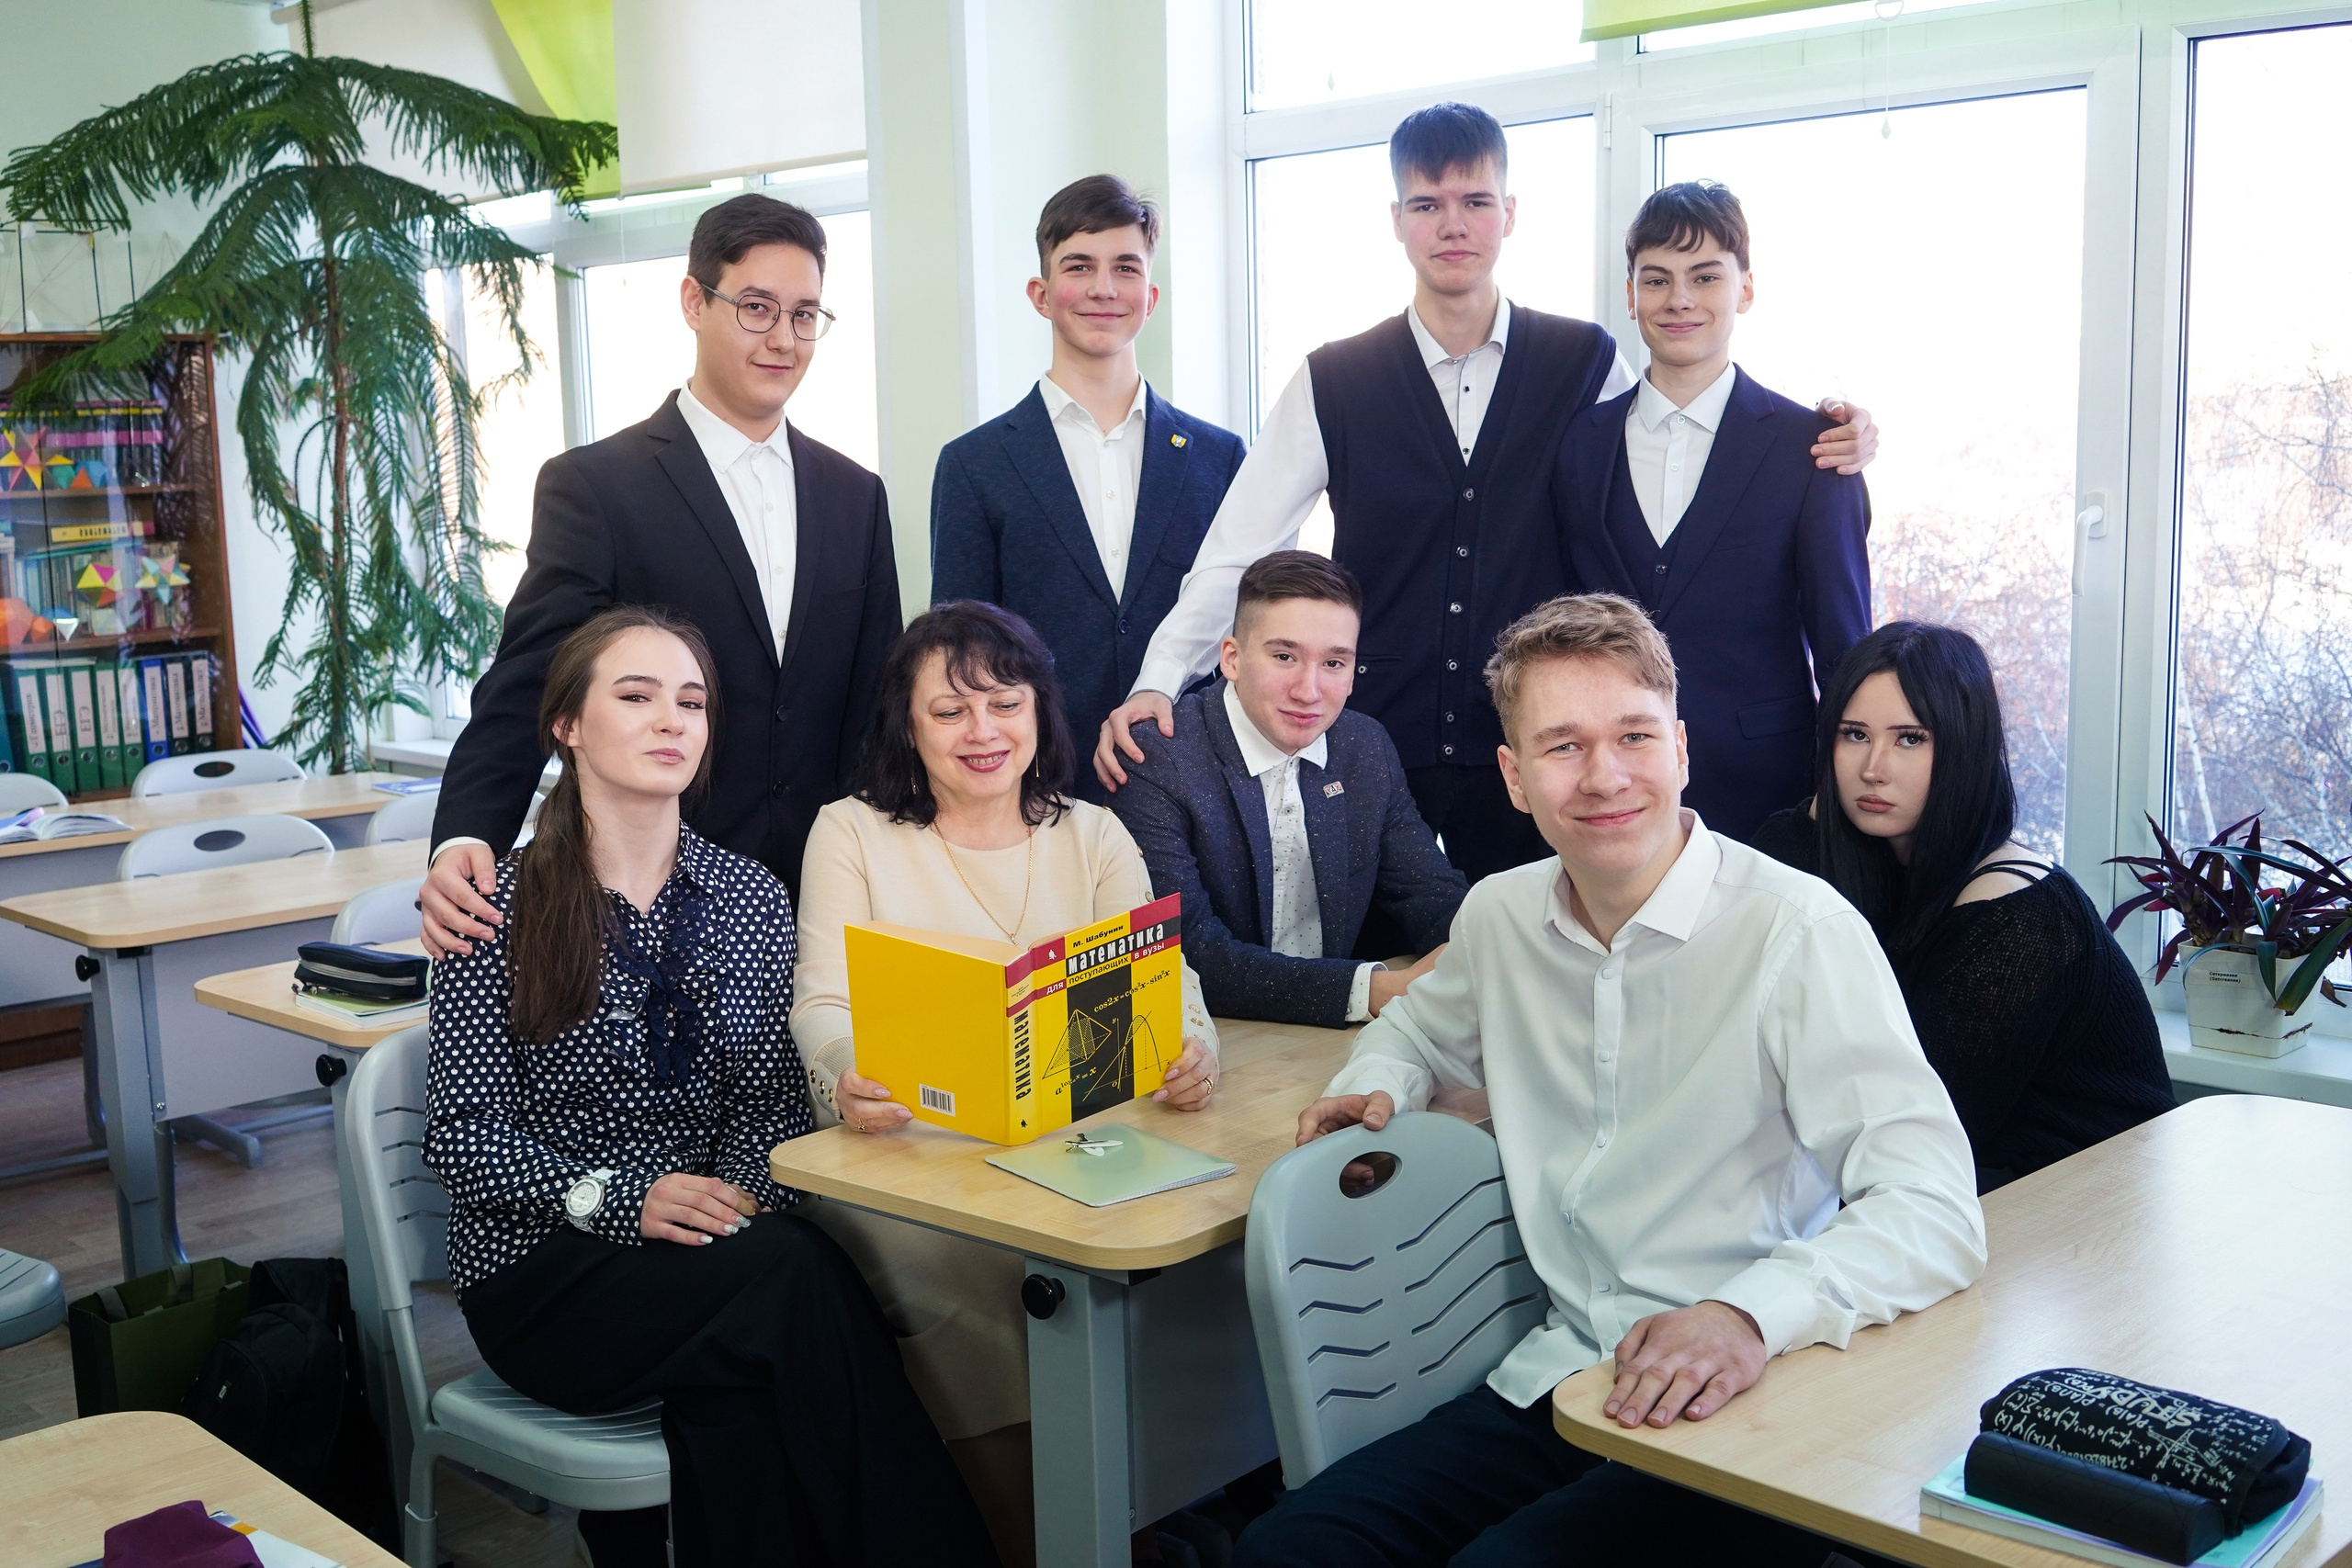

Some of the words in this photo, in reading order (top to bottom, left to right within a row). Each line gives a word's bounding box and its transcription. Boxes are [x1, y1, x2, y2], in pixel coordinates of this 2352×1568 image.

[1068, 923, 1164, 976] математика
[1072, 941, 1084, 949] М.
[1085, 925, 1124, 943] Шабунин
[1046, 981, 1064, 996] для
[1069, 955, 1129, 985] поступающих
[1134, 952, 1140, 960] в
[1142, 942, 1165, 957] вузы
[1013, 1010, 1032, 1101] математика
